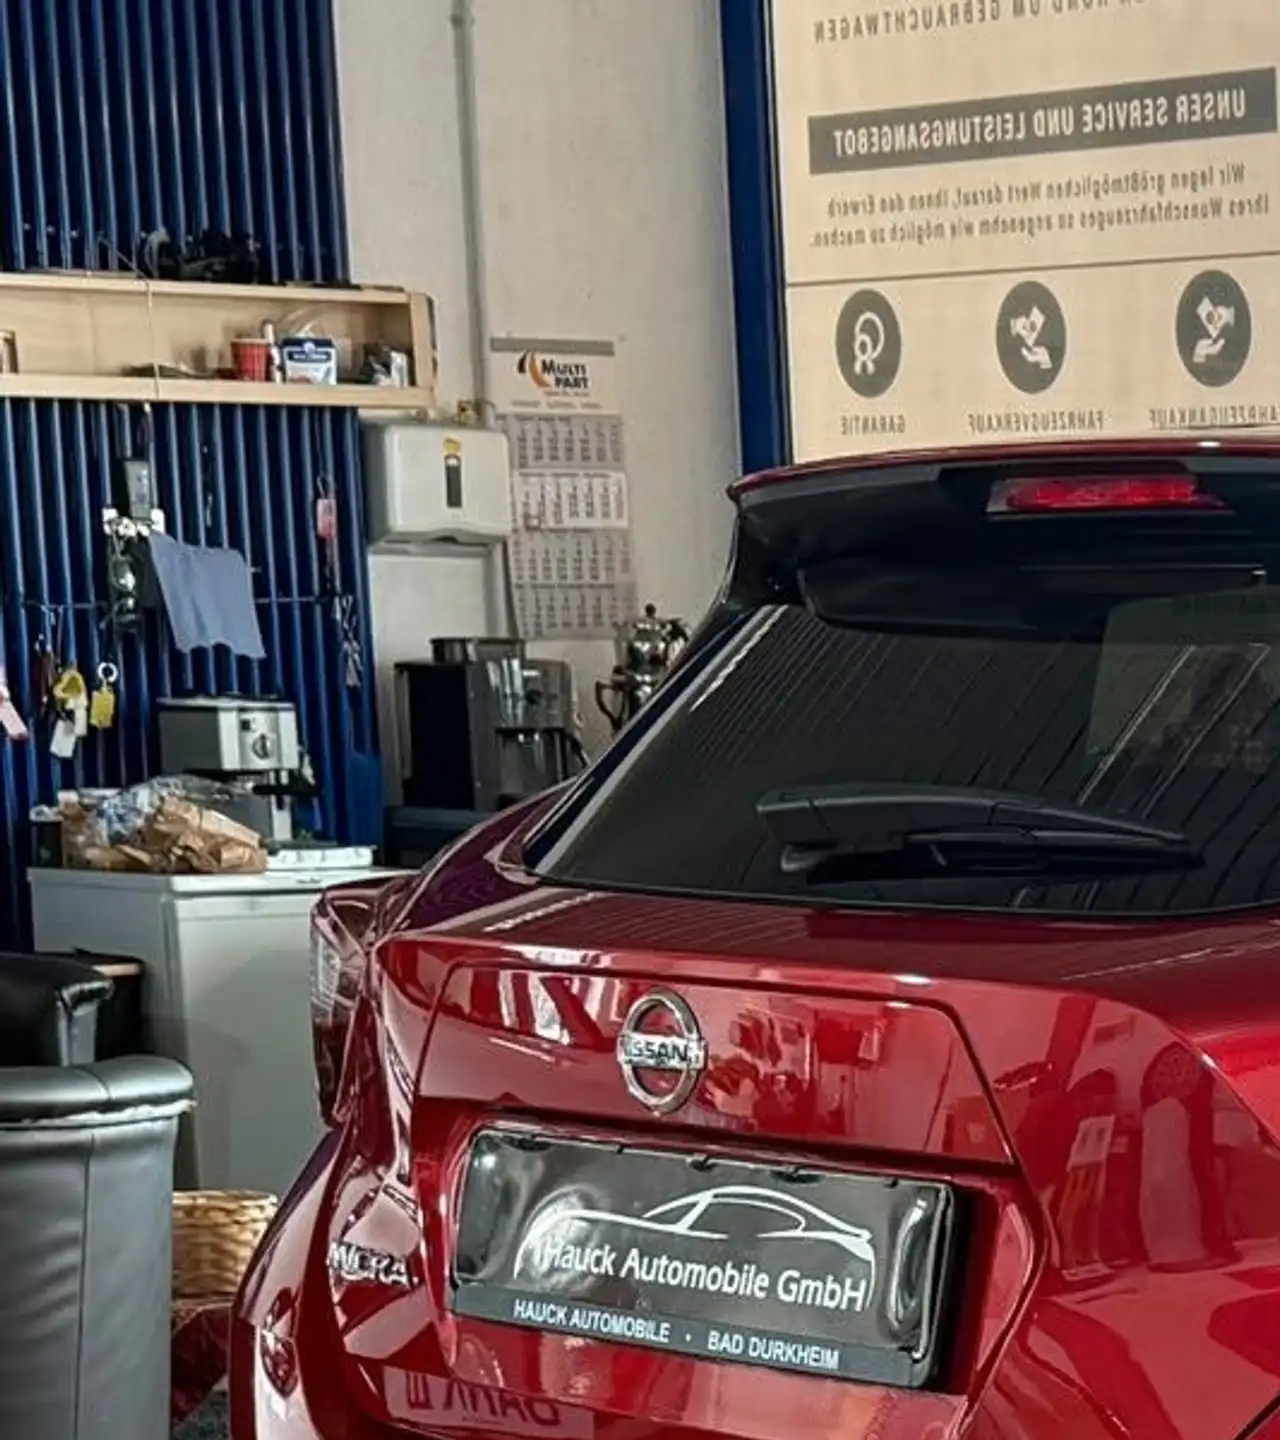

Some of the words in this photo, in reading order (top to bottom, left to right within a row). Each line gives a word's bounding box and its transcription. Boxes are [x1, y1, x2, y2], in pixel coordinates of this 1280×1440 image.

[543, 1236, 617, 1277] Hauck
[619, 1246, 769, 1299] Automobile
[776, 1269, 867, 1313] GmbH
[513, 1299, 567, 1327] HAUCK
[569, 1308, 671, 1344] AUTOMOBILE
[706, 1330, 743, 1356] BAD
